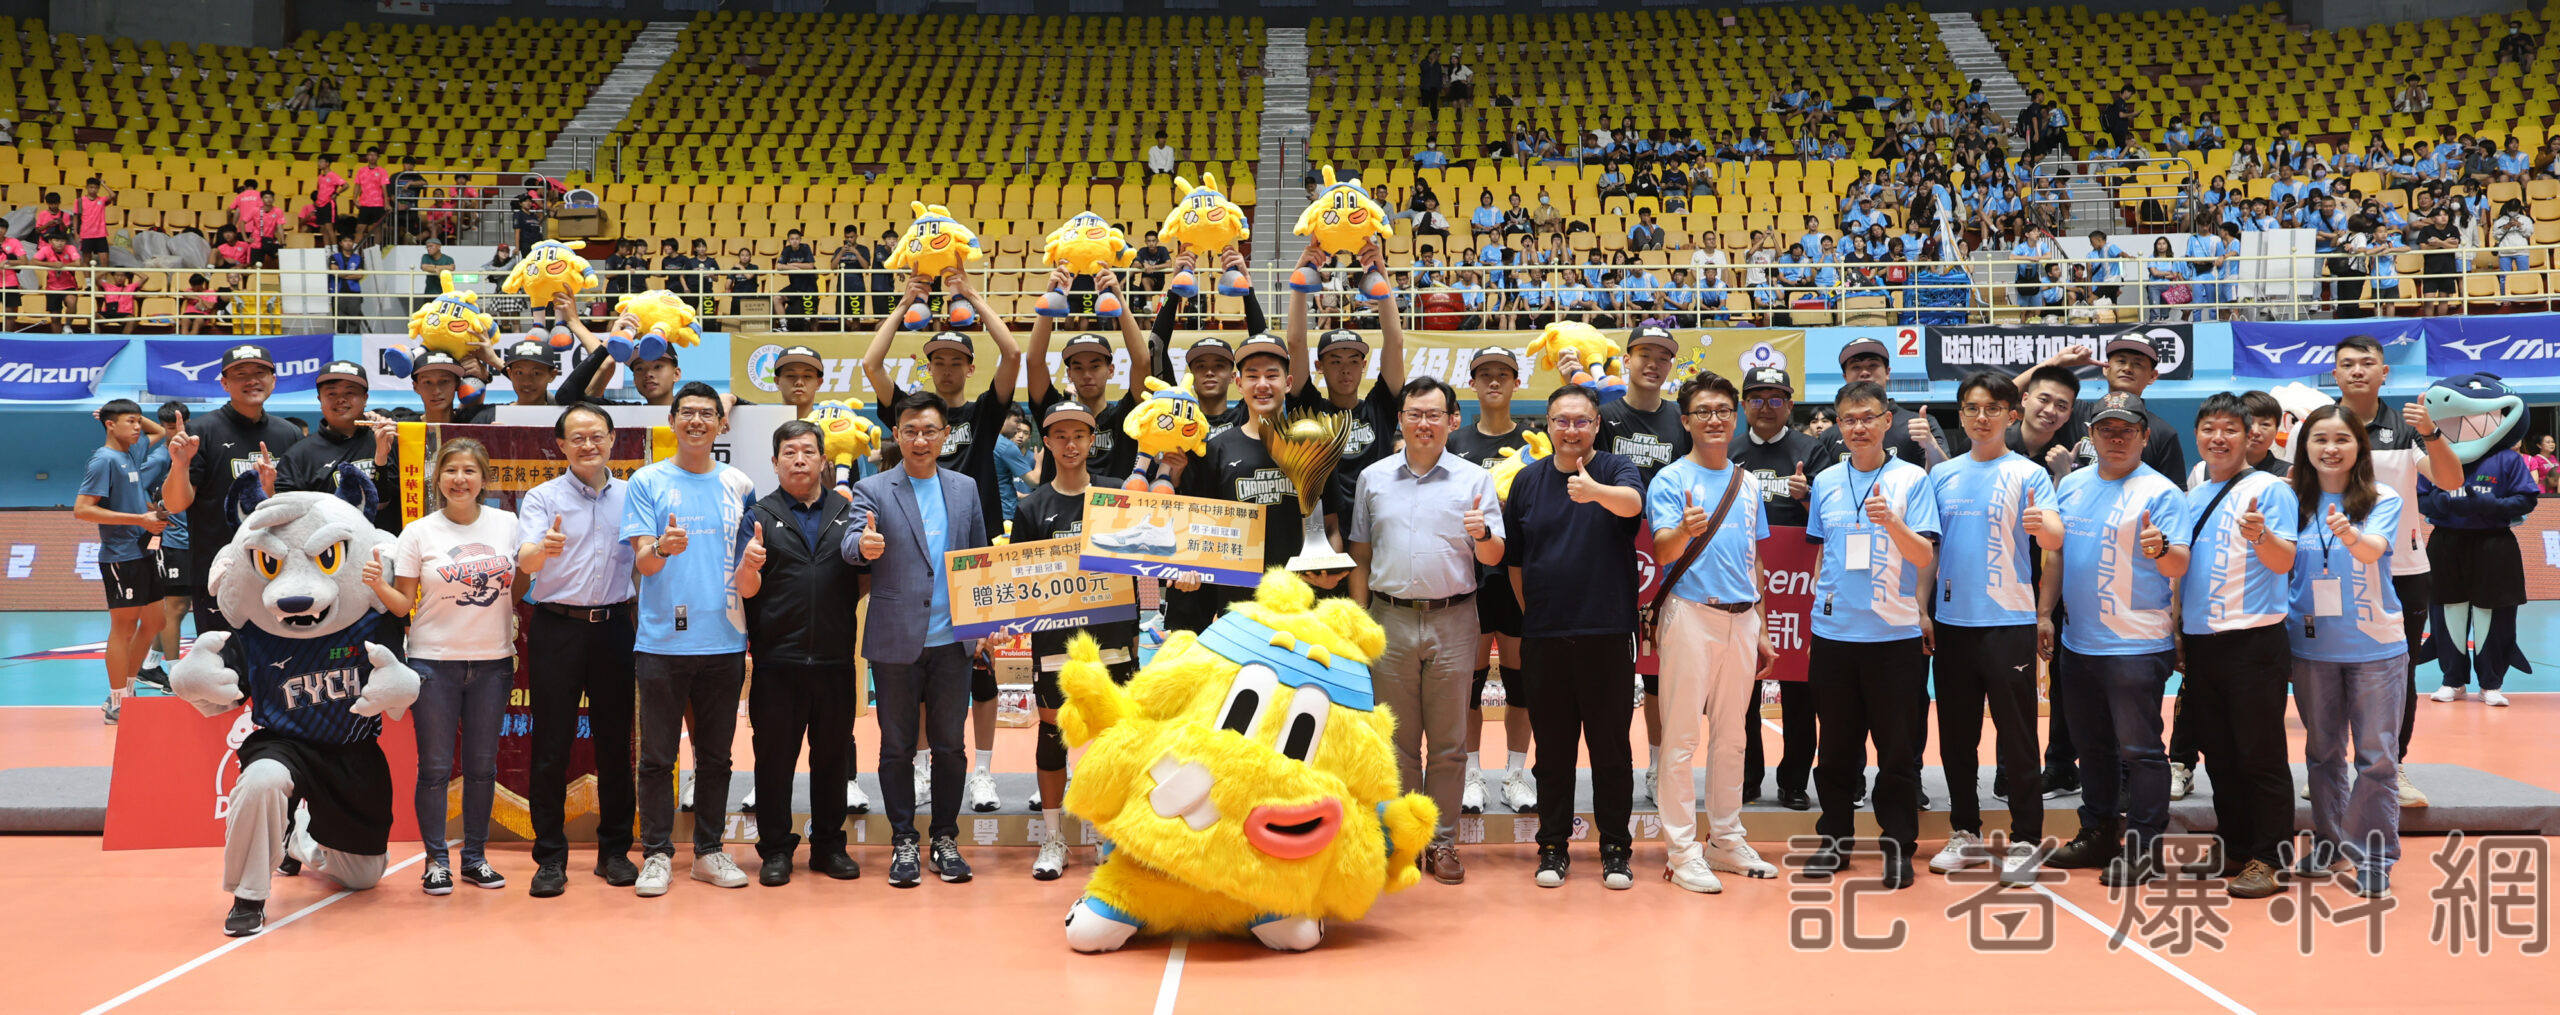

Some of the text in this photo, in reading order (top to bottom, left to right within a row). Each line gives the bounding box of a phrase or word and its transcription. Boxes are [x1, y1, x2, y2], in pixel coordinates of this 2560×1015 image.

[1898, 329, 1918, 356] 2
[1614, 437, 1672, 463] CHAMPIONS
[1632, 456, 1652, 467] 2024
[404, 464, 419, 519] 中華民國
[1237, 479, 1298, 499] CHAMPION
[1258, 492, 1280, 504] 2024
[1090, 493, 1131, 509] HVL
[1138, 498, 1259, 520] 112 學年 高中排球聯賽
[1191, 524, 1241, 538] 男子組冠軍
[1986, 472, 2011, 588] ZEROING
[998, 551, 1019, 563] 112
[1022, 546, 1045, 560] 學年
[1187, 539, 1244, 557] 新款球鞋
[2097, 487, 2134, 616] ZEROING
[2208, 491, 2241, 620] ZEROING
[7, 544, 35, 578] 2
[437, 555, 512, 583] WEIDER
[952, 553, 992, 571] HVL
[1015, 562, 1064, 576] 男子組冠軍
[168, 568, 179, 578] 13
[125, 588, 134, 599] 8
[973, 572, 1110, 607] 贈送36,000元
[284, 667, 362, 711] FYCH
